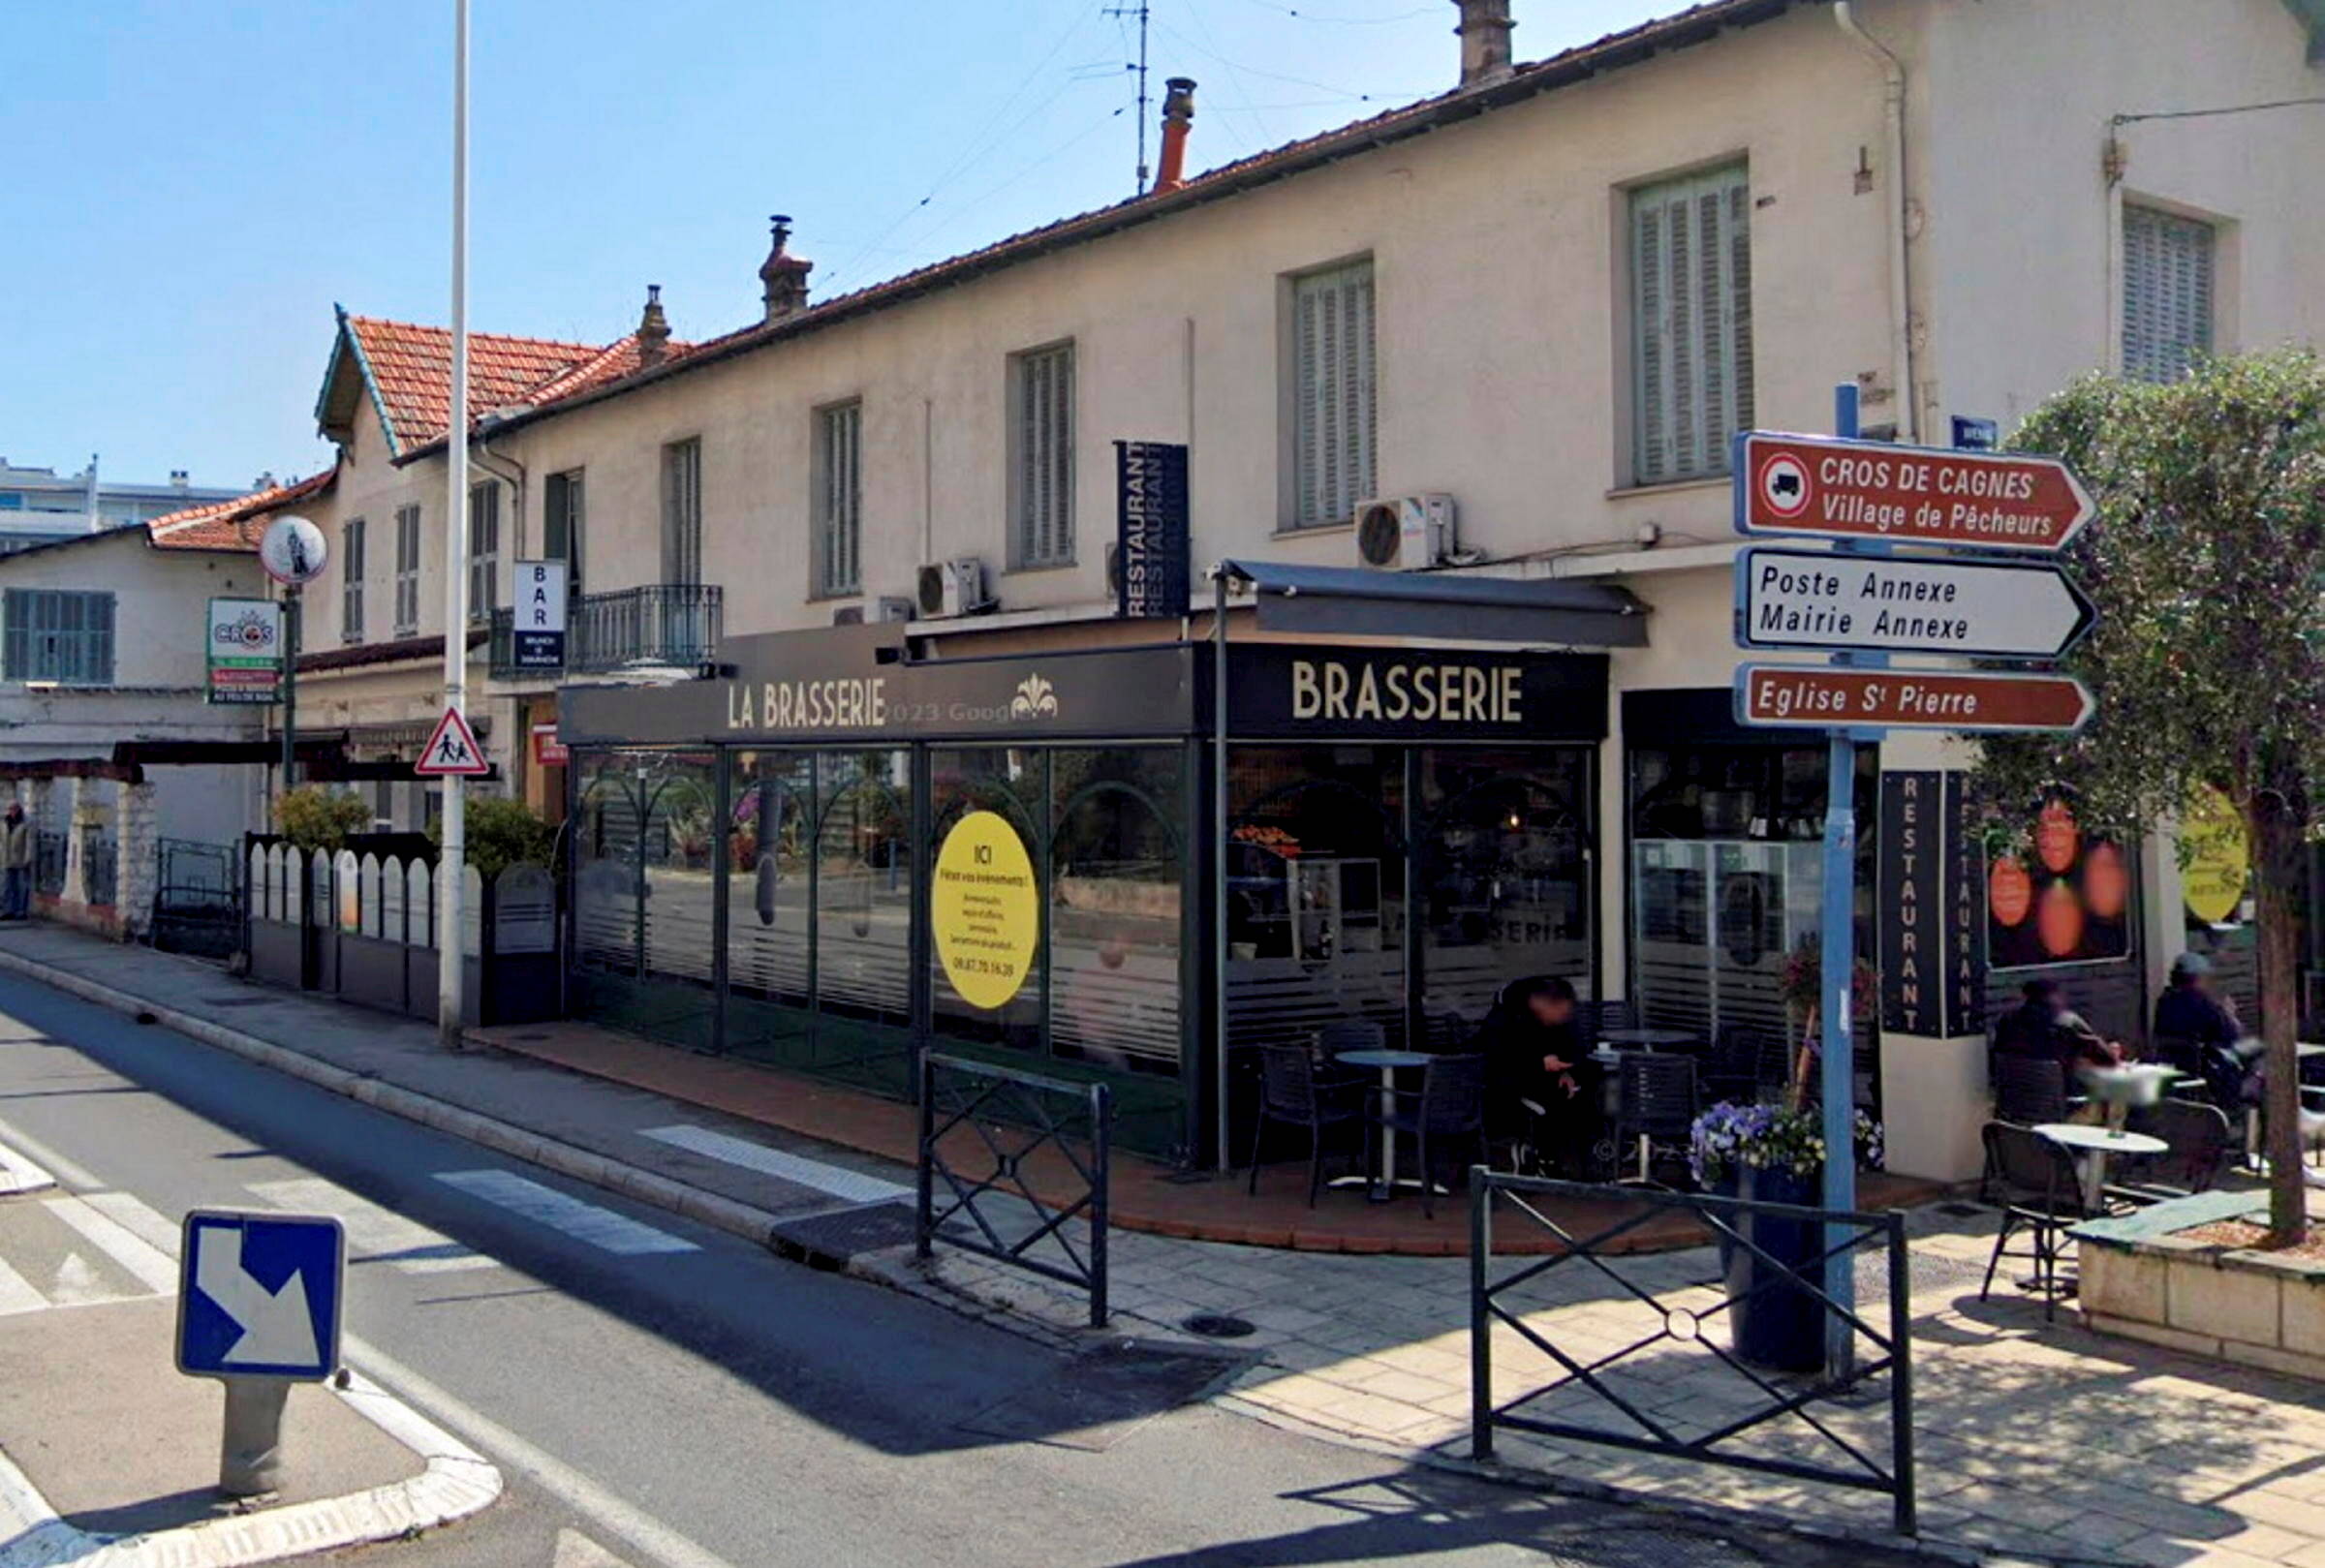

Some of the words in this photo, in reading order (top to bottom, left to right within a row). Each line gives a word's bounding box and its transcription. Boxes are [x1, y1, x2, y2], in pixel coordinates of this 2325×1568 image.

[1819, 457, 1890, 487] CROS
[1899, 463, 1930, 491] DE
[1938, 467, 2033, 499] CAGNES
[1127, 441, 1145, 617] RESTAURANT
[1823, 493, 1906, 532] Village
[1915, 501, 1941, 528] de
[1949, 503, 2053, 536] Pêcheurs
[534, 566, 546, 626] BAR
[1760, 566, 1840, 597] Poste
[1861, 572, 1956, 602] Annexe
[214, 623, 273, 646] CROS
[1759, 603, 1851, 634] Mairie
[1873, 609, 1968, 639] Annexe
[728, 684, 755, 728] LA
[762, 678, 885, 728] BRASSERIE
[1291, 660, 1523, 723] BRASSERIE
[1758, 680, 1846, 715] Eglise
[1861, 684, 1887, 712] St
[1899, 686, 1978, 714] Pierre
[975, 845, 992, 865] ICI
[1902, 777, 1918, 1030] RESTAURANT
